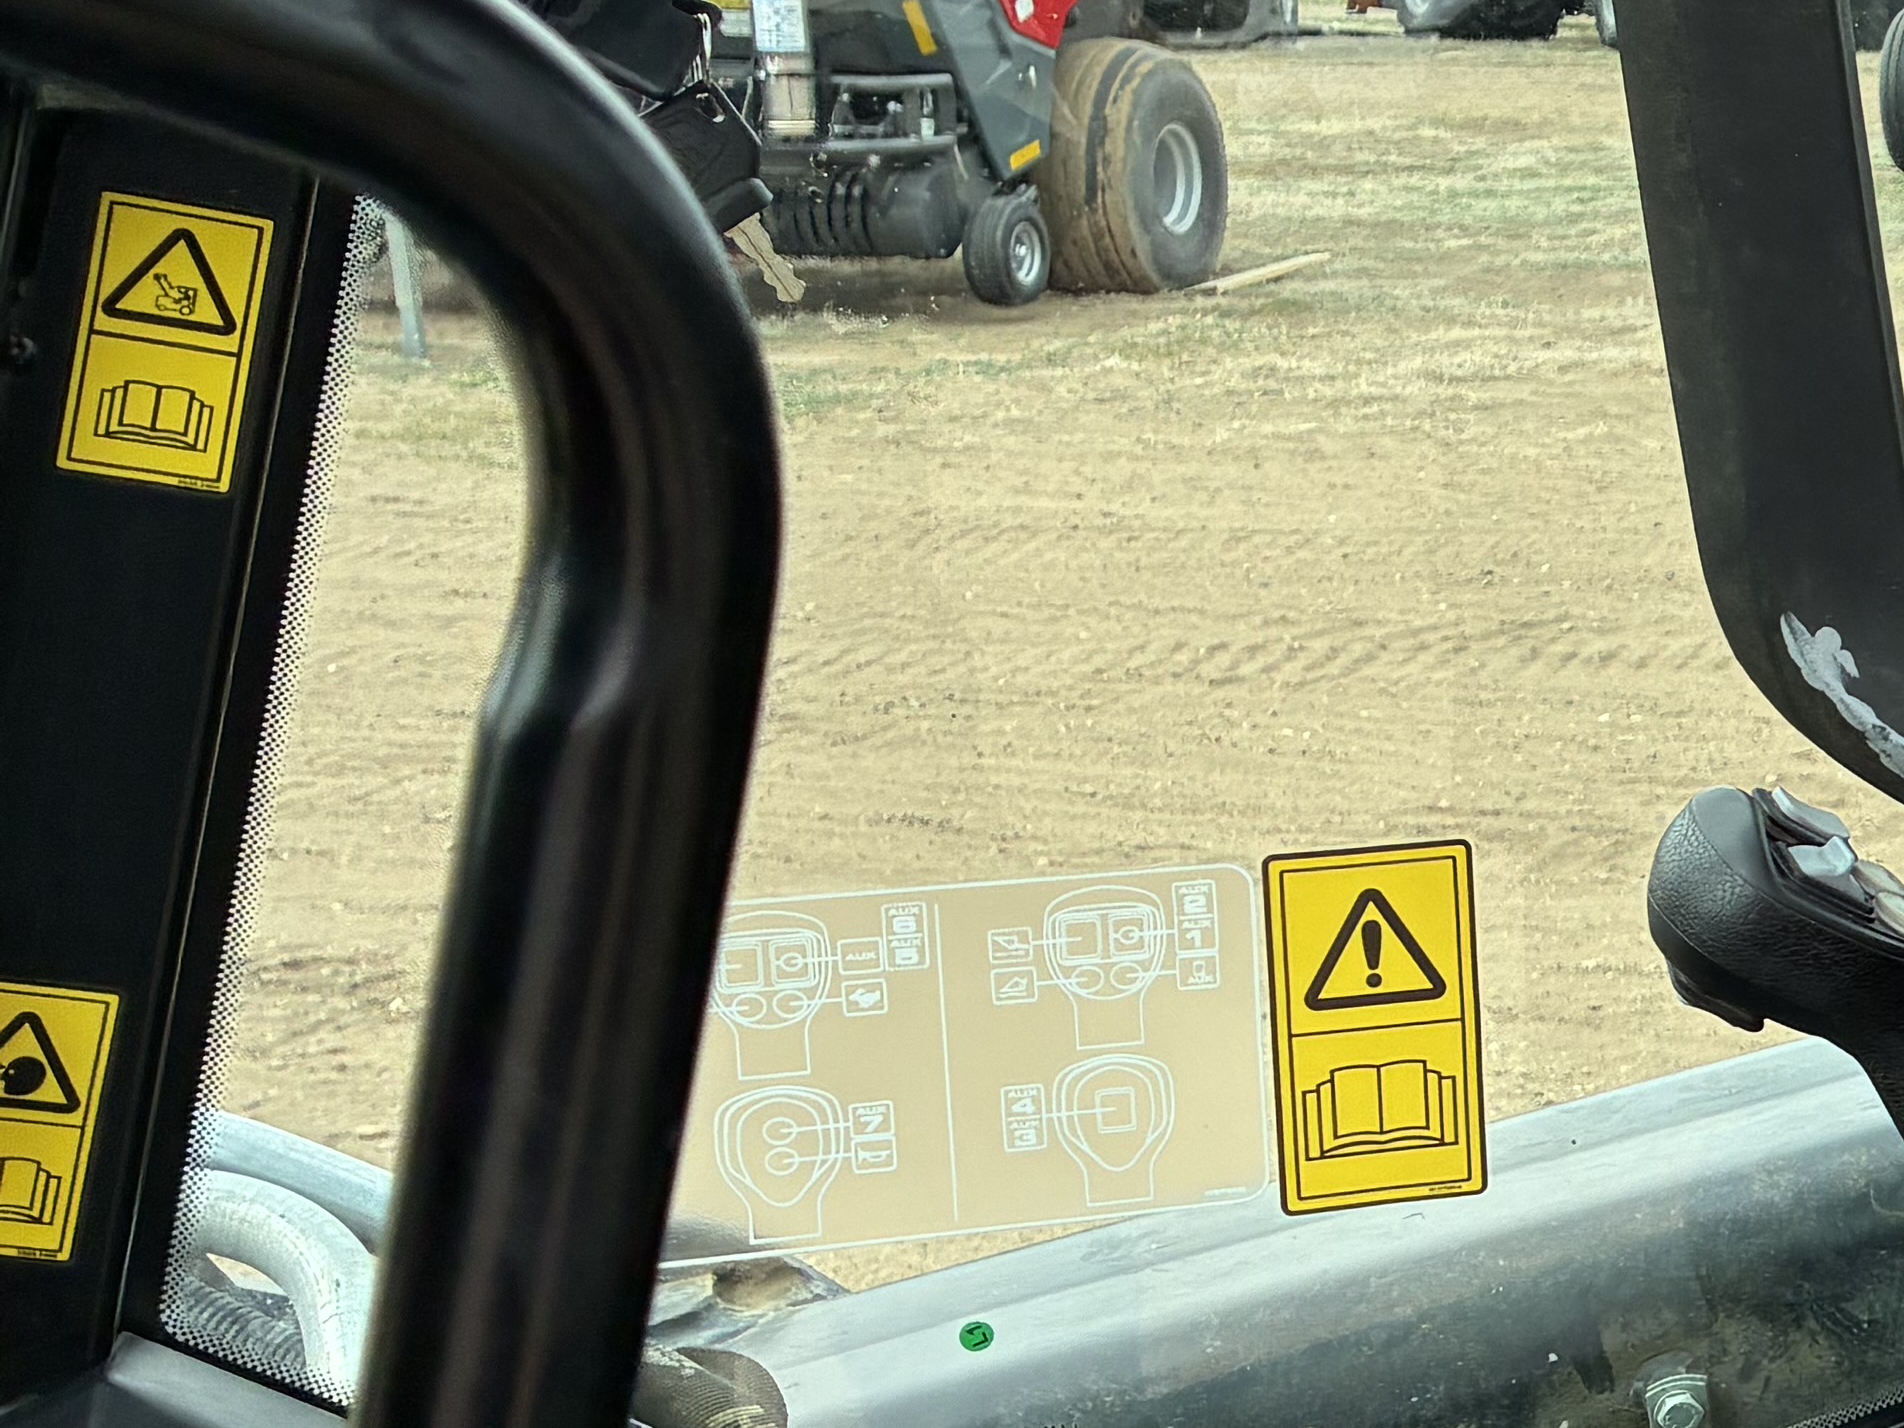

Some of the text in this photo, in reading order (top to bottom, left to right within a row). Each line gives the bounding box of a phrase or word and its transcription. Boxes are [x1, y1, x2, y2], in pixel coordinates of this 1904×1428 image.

[1178, 885, 1210, 894] AUX
[1183, 894, 1208, 914] 2
[888, 906, 921, 917] AUX
[1182, 919, 1212, 929] AUX
[890, 938, 922, 948] AUX
[1185, 929, 1202, 948] 1
[845, 951, 878, 961] AUX
[1007, 1088, 1038, 1099] AUX
[855, 1105, 888, 1116] AUX
[1011, 1098, 1036, 1114] 4
[860, 1115, 884, 1134] 7
[1009, 1119, 1040, 1130] AUX
[1014, 1128, 1037, 1147] 3
